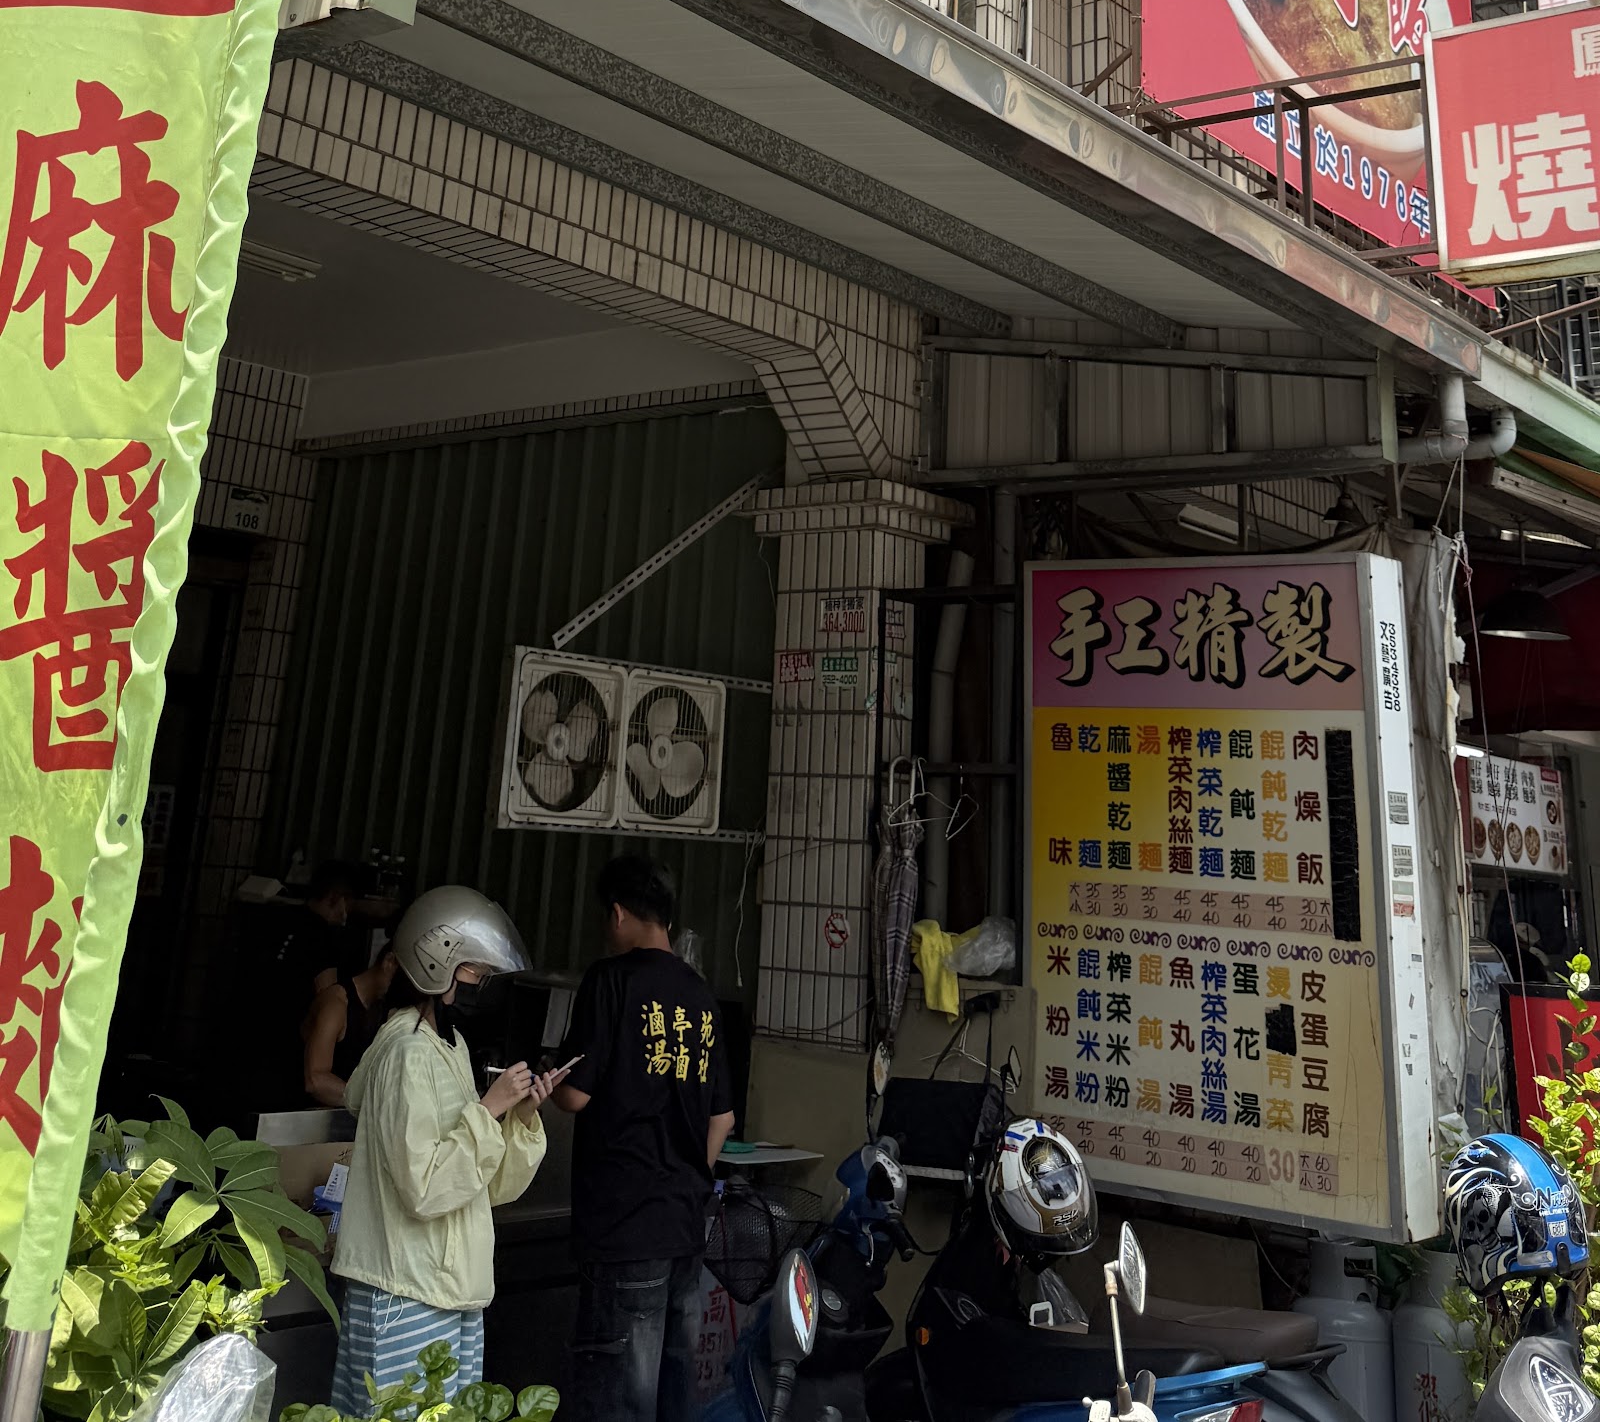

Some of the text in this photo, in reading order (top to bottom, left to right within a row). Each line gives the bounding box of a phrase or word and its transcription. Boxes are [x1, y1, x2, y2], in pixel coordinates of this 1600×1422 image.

[235, 512, 259, 530] 108
[1049, 581, 1357, 689] 手工精製
[1388, 622, 1401, 712] 3534338
[1048, 723, 1074, 866] 魯味
[1078, 724, 1102, 869] 乾麵
[1107, 725, 1132, 870] 麻醬乾麵
[1136, 725, 1164, 872] 湯麵
[1167, 726, 1193, 875] 榨菜肉絲麵
[1196, 728, 1225, 877] 榨菜乾麵
[1228, 729, 1257, 881] 餛飩麵
[1260, 730, 1290, 883] 餛飩乾麵
[1293, 731, 1325, 885] 肉燥飯
[1069, 882, 1331, 916] 大 35 35 35 45 45 45 45 30 大
[1085, 901, 1101, 916] 30
[1112, 902, 1128, 917] 30
[1143, 905, 1158, 919] 30
[1173, 908, 1192, 922] 40
[1202, 910, 1219, 925] 40
[1233, 912, 1251, 928] 40
[1268, 915, 1286, 930] 40
[1300, 916, 1317, 932] 20
[1045, 945, 1071, 1100] 米粉湯
[1075, 947, 1101, 1104] 餛飩米粉
[1104, 950, 1132, 1108] 榨菜米粉
[1136, 953, 1163, 1114] 餛飩湯
[1168, 956, 1195, 1119] 魚丸湯
[1200, 960, 1227, 1125] 榨菜肉絲湯
[1233, 962, 1261, 1128] 蛋花湯
[1301, 970, 1329, 1138] 皮蛋豆腐
[1077, 1121, 1094, 1136] 45
[1108, 1126, 1125, 1142] 45
[1142, 1130, 1160, 1146] 40
[1178, 1135, 1195, 1152] 40
[1207, 1140, 1225, 1157] 40
[1241, 1145, 1260, 1163] 40
[1268, 1147, 1295, 1183] 30
[1315, 1155, 1330, 1172] 60
[1078, 1139, 1095, 1154] 40
[1109, 1144, 1126, 1161] 40
[1146, 1150, 1161, 1167] 20
[1181, 1156, 1196, 1173] 20
[1211, 1160, 1227, 1176] 20
[1245, 1165, 1261, 1182] 20
[1317, 1175, 1331, 1191] 30
